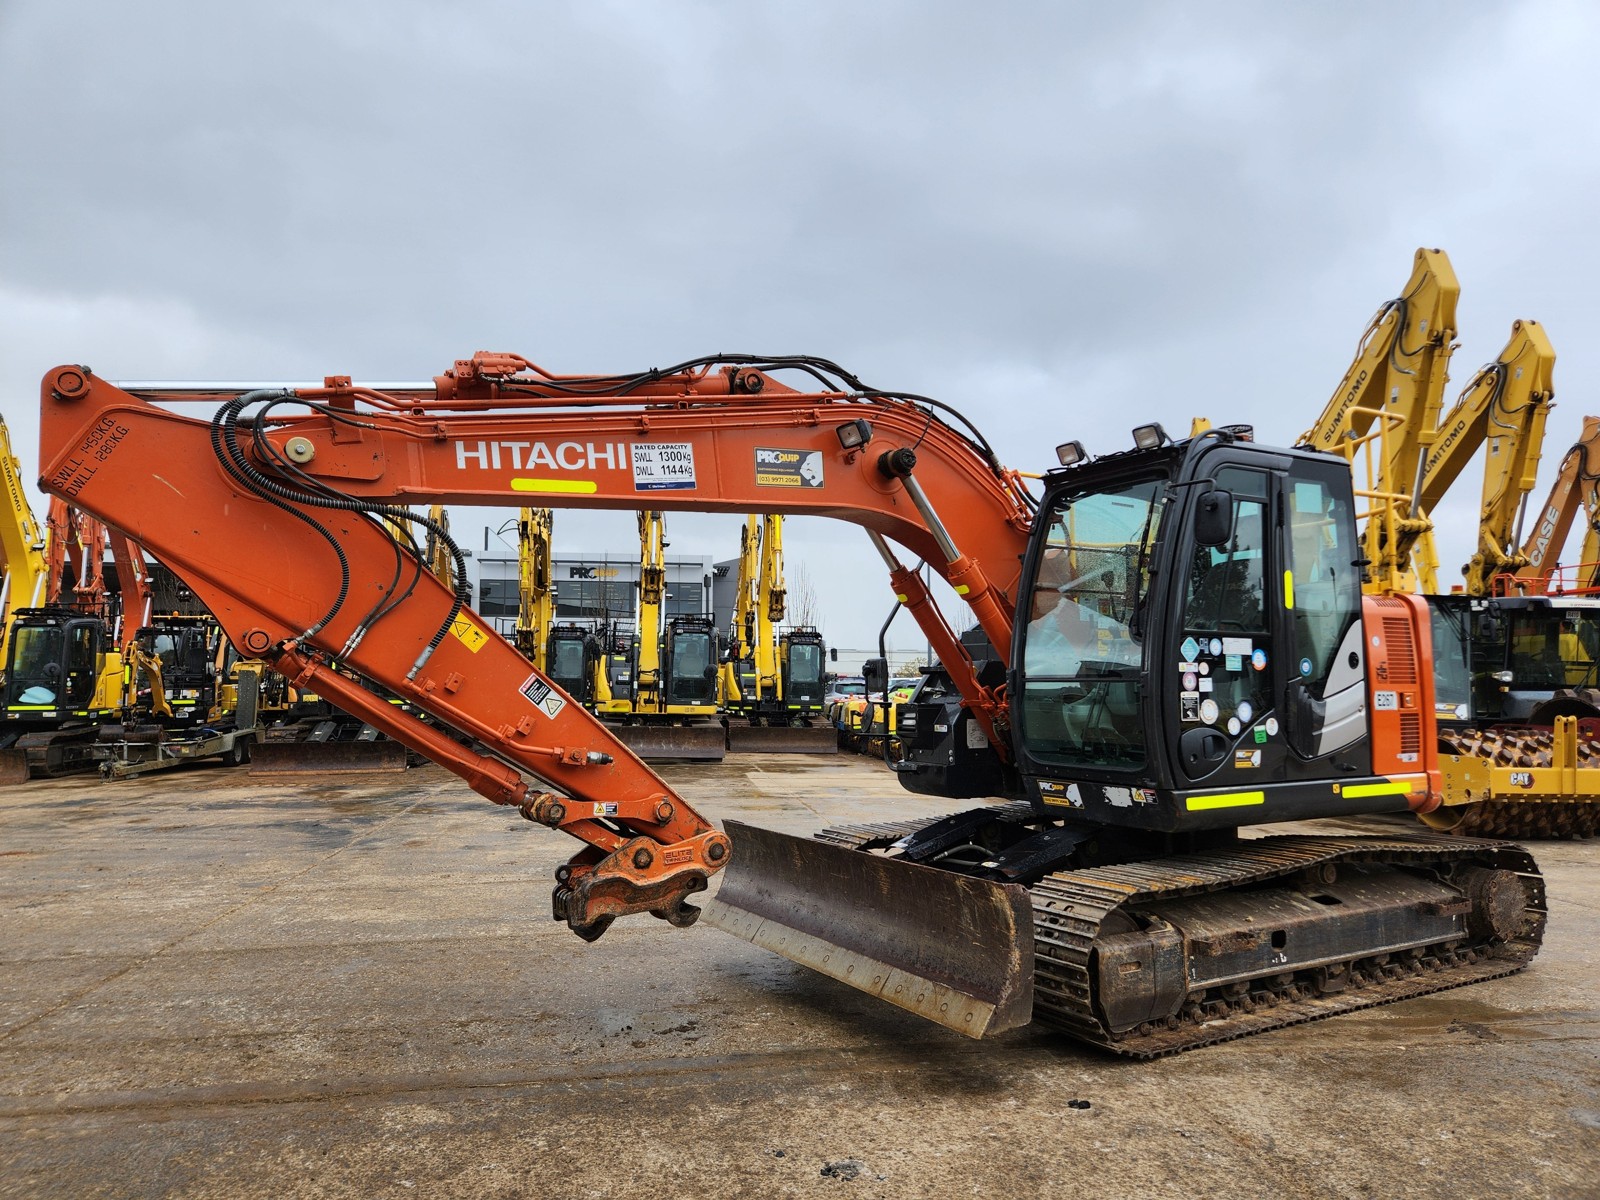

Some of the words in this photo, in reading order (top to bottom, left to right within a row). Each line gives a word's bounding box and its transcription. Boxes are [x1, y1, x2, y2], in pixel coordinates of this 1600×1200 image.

[1324, 370, 1368, 443] SUMITOMO
[52, 459, 84, 488] S.W.L.L.
[81, 418, 116, 453] 1450K.G.
[66, 467, 98, 496] D.W.L.L.
[94, 426, 130, 462] 1280K.G.
[455, 440, 627, 470] HITACHI
[634, 452, 653, 462] SWLL
[757, 450, 800, 463] PROQUIP
[636, 466, 654, 476] DWLL
[759, 475, 770, 483] (03)
[2, 456, 21, 512] SUMITOMO
[1530, 505, 1559, 567] CASE
[1377, 693, 1395, 707] E267
[1510, 772, 1530, 786] CAT
